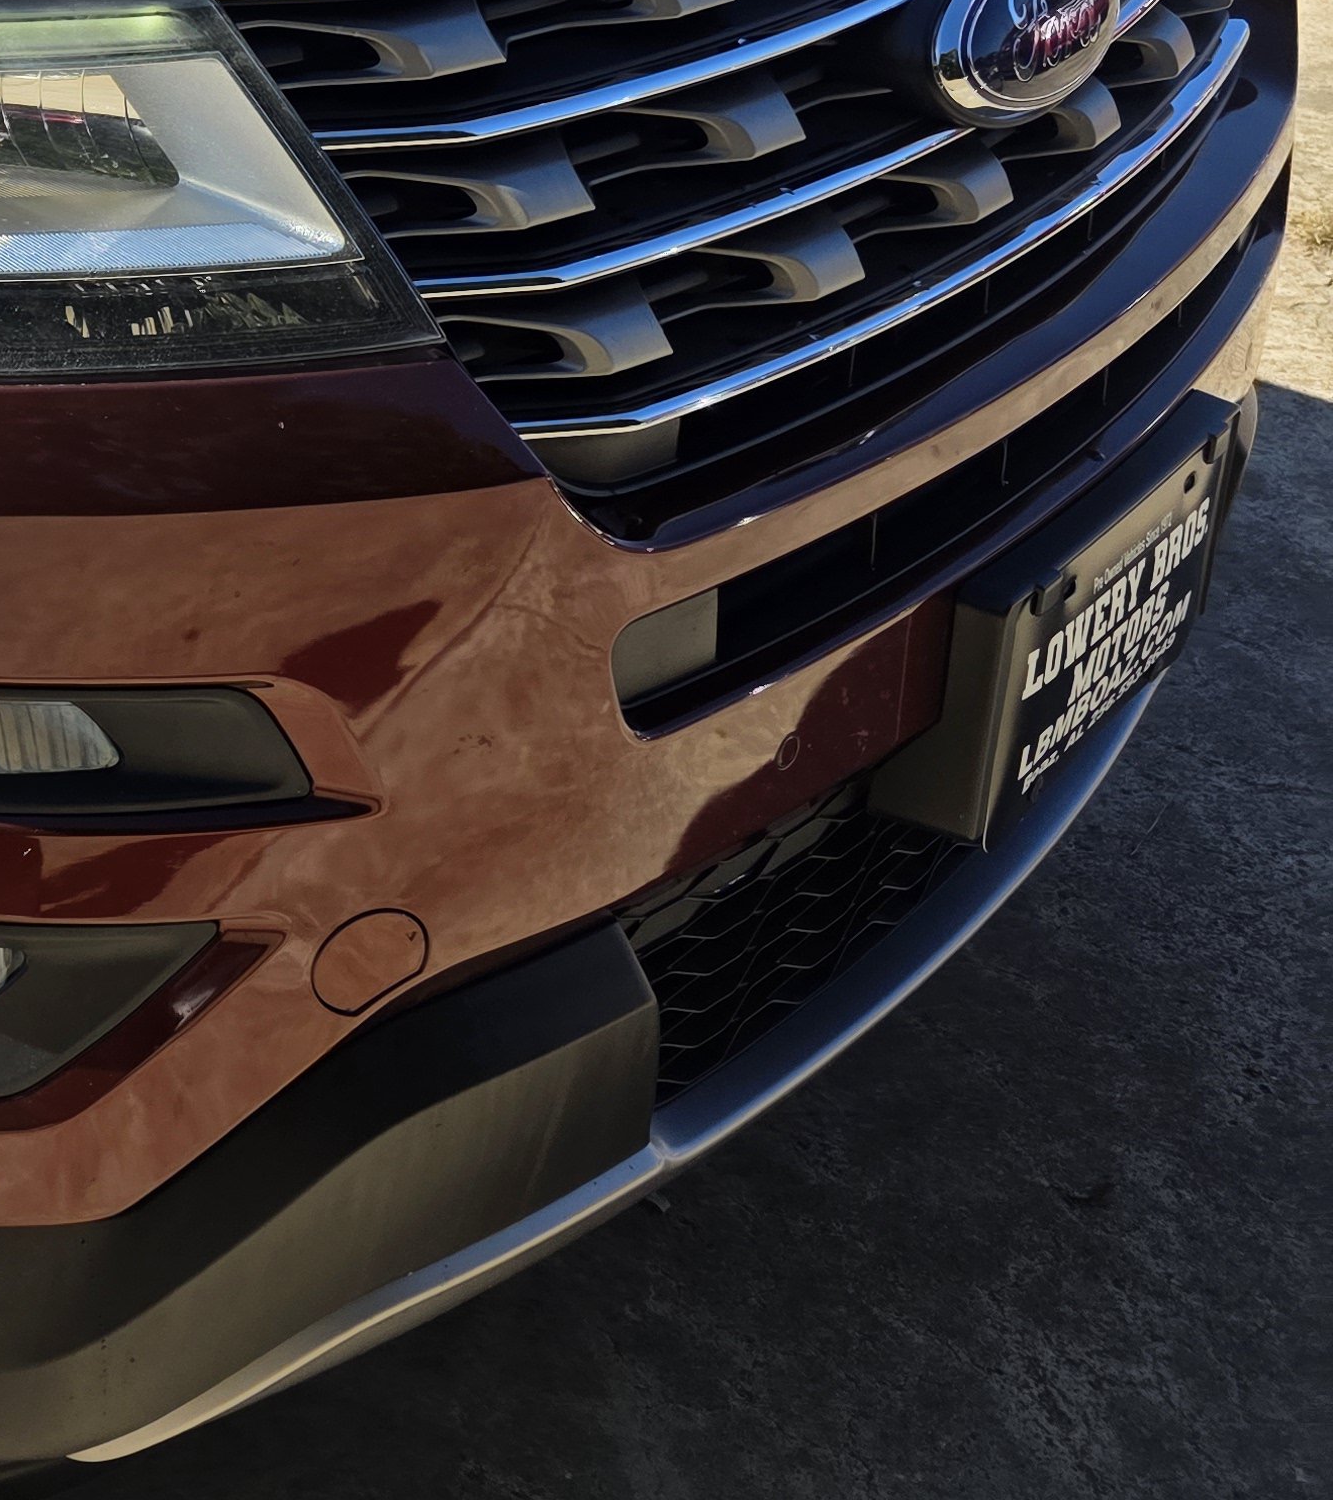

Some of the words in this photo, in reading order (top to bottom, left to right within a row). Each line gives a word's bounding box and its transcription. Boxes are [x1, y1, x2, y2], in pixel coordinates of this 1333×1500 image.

[1022, 557, 1146, 700] LOWERY
[1149, 497, 1211, 591] BROS.
[1066, 580, 1171, 708] MOTORS
[1093, 576, 1104, 595] Pre
[1017, 590, 1192, 781] LBMBOAZ.COM
[1064, 725, 1085, 752] AL
